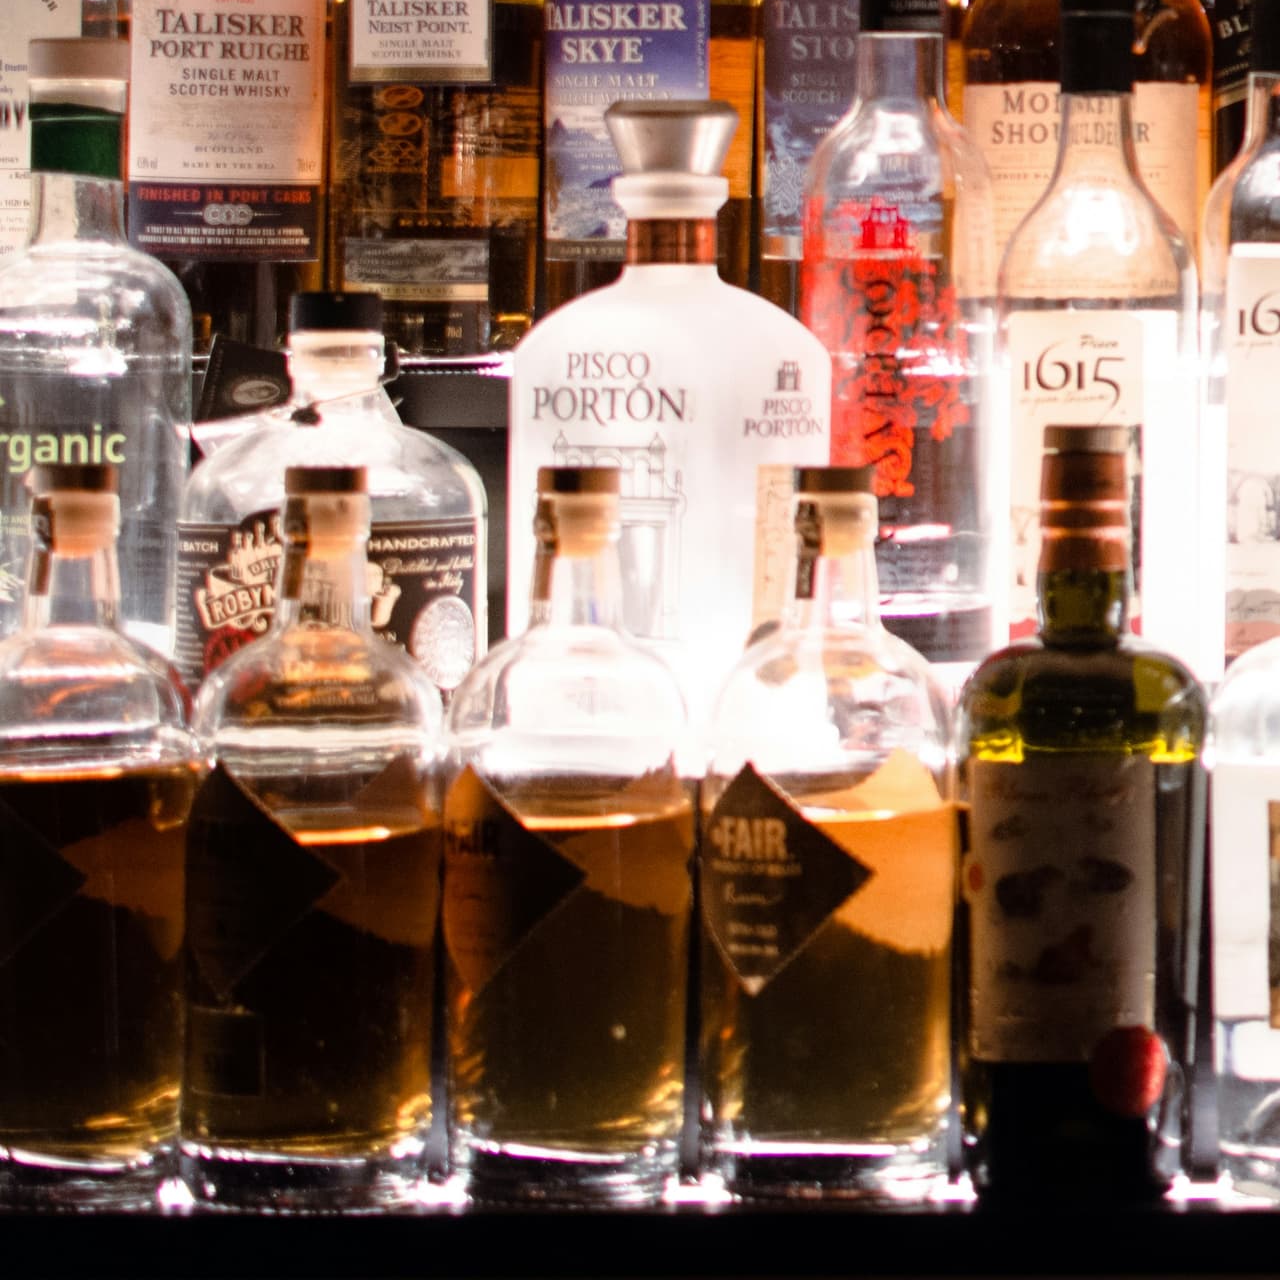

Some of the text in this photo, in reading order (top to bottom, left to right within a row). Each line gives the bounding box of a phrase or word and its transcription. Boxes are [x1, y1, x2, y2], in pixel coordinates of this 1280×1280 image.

[367, 0, 470, 18] TALISKER
[546, 3, 688, 31] TALISKER
[157, 9, 305, 38] TALISKER
[367, 21, 412, 34] NEIST
[150, 40, 310, 62] PORT RUIGHE
[379, 39, 453, 48] SINGLE MALT
[561, 38, 644, 64] SKYE
[371, 49, 462, 59] SCOTCH WHISKY
[182, 68, 280, 82] SINGLE MALT
[169, 84, 291, 99] SCOTCH WHISKY
[138, 188, 267, 203] FINISHED IN PORT
[567, 352, 650, 380] PISCO
[1022, 345, 1126, 412] 1615
[532, 382, 687, 425] PORTÓN
[762, 399, 811, 415] PISCO
[743, 416, 824, 439] PORTÓN
[369, 536, 475, 551] HANDCRAFTED
